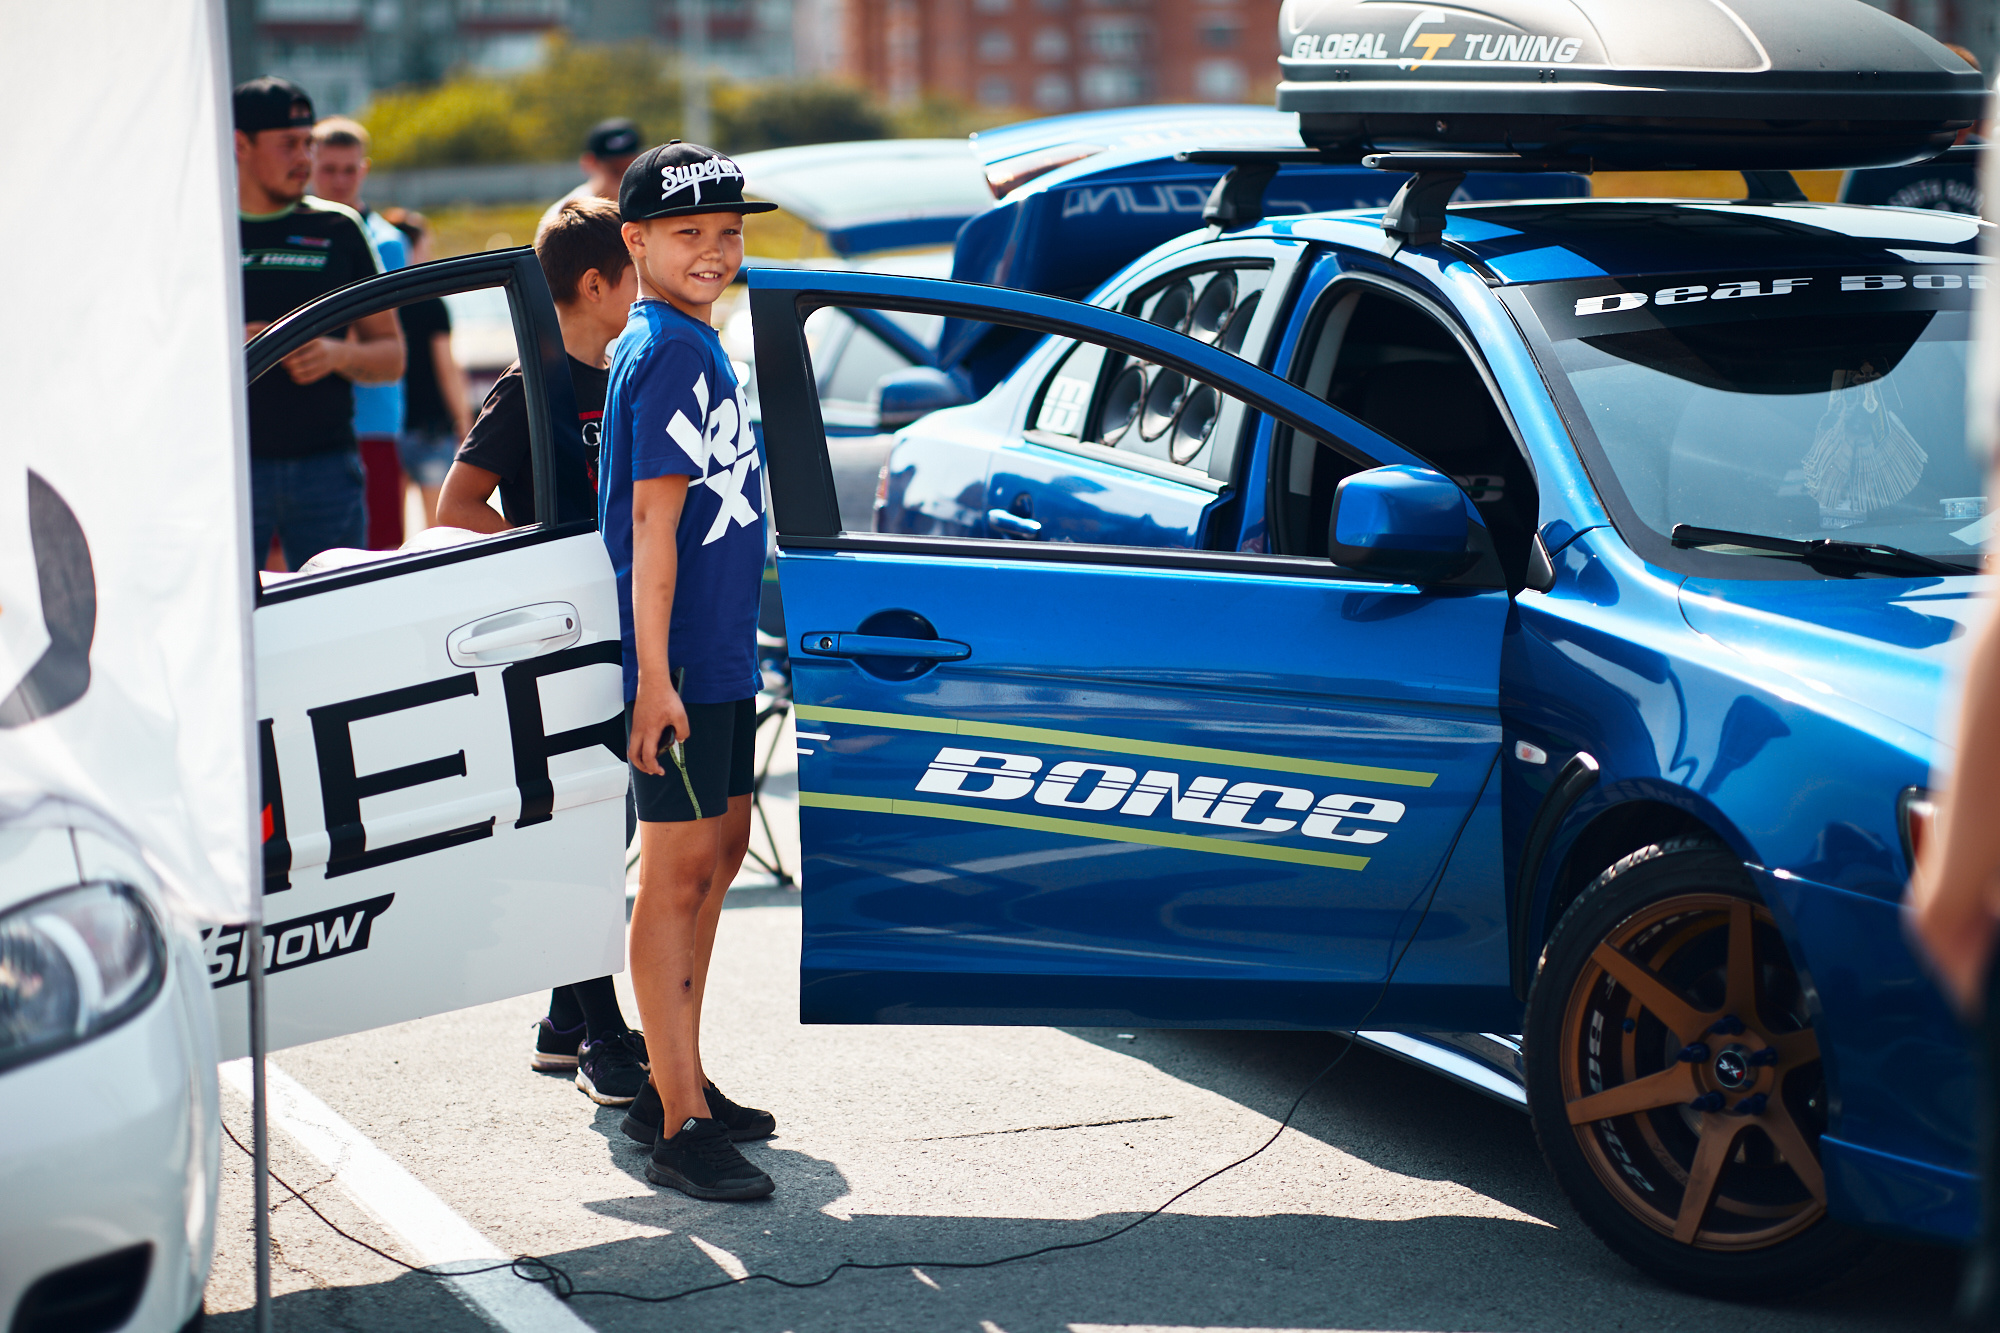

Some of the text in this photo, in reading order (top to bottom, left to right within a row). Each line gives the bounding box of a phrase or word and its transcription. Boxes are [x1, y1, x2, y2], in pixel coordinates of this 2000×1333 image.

[1291, 33, 1388, 59] GLOBAL
[1464, 33, 1583, 63] TUNING
[257, 640, 628, 896] ER
